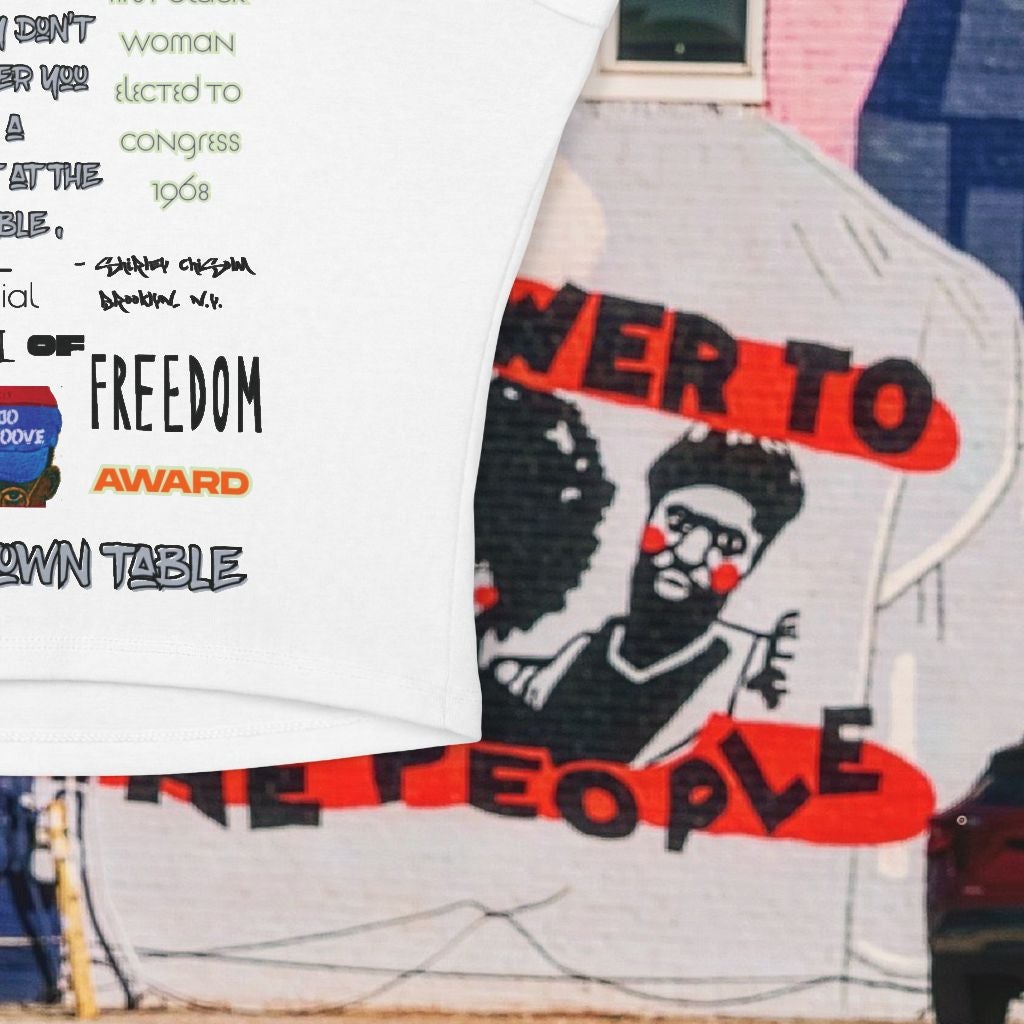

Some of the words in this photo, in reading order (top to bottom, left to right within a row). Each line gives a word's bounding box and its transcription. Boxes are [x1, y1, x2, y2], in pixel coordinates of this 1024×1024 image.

[14, 11, 96, 44] DON'T
[39, 64, 89, 101] YOU
[5, 113, 25, 142] A
[9, 162, 46, 191] AT
[46, 162, 104, 191] THE
[151, 174, 209, 209] 1968
[27, 335, 85, 356] OF
[91, 354, 262, 433] FREEDOM
[785, 339, 934, 455] TO
[93, 467, 250, 496] AWARD
[99, 542, 248, 593] TABLE
